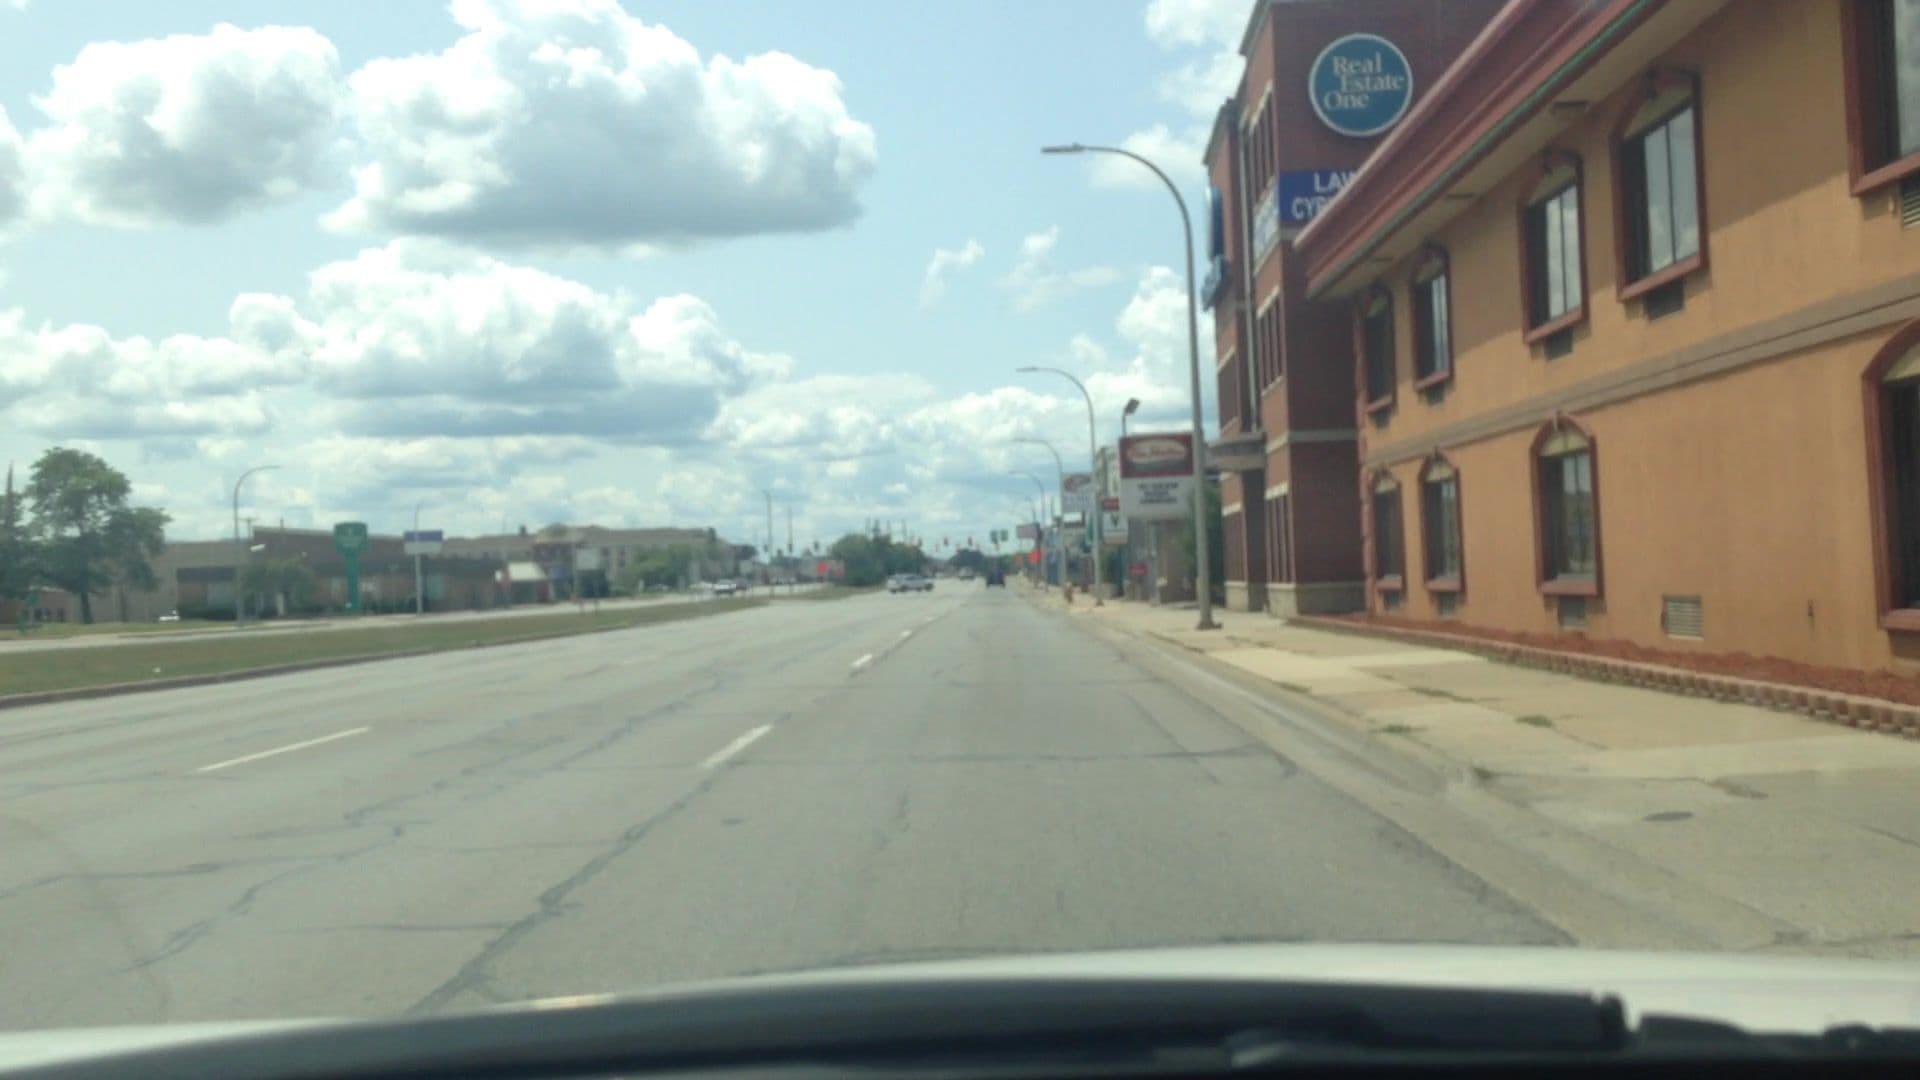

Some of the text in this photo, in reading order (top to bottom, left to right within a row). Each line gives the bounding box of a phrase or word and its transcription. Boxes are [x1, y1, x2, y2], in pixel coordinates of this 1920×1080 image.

[1333, 53, 1382, 75] Real
[1341, 73, 1404, 92] Estate
[1325, 91, 1369, 110] One
